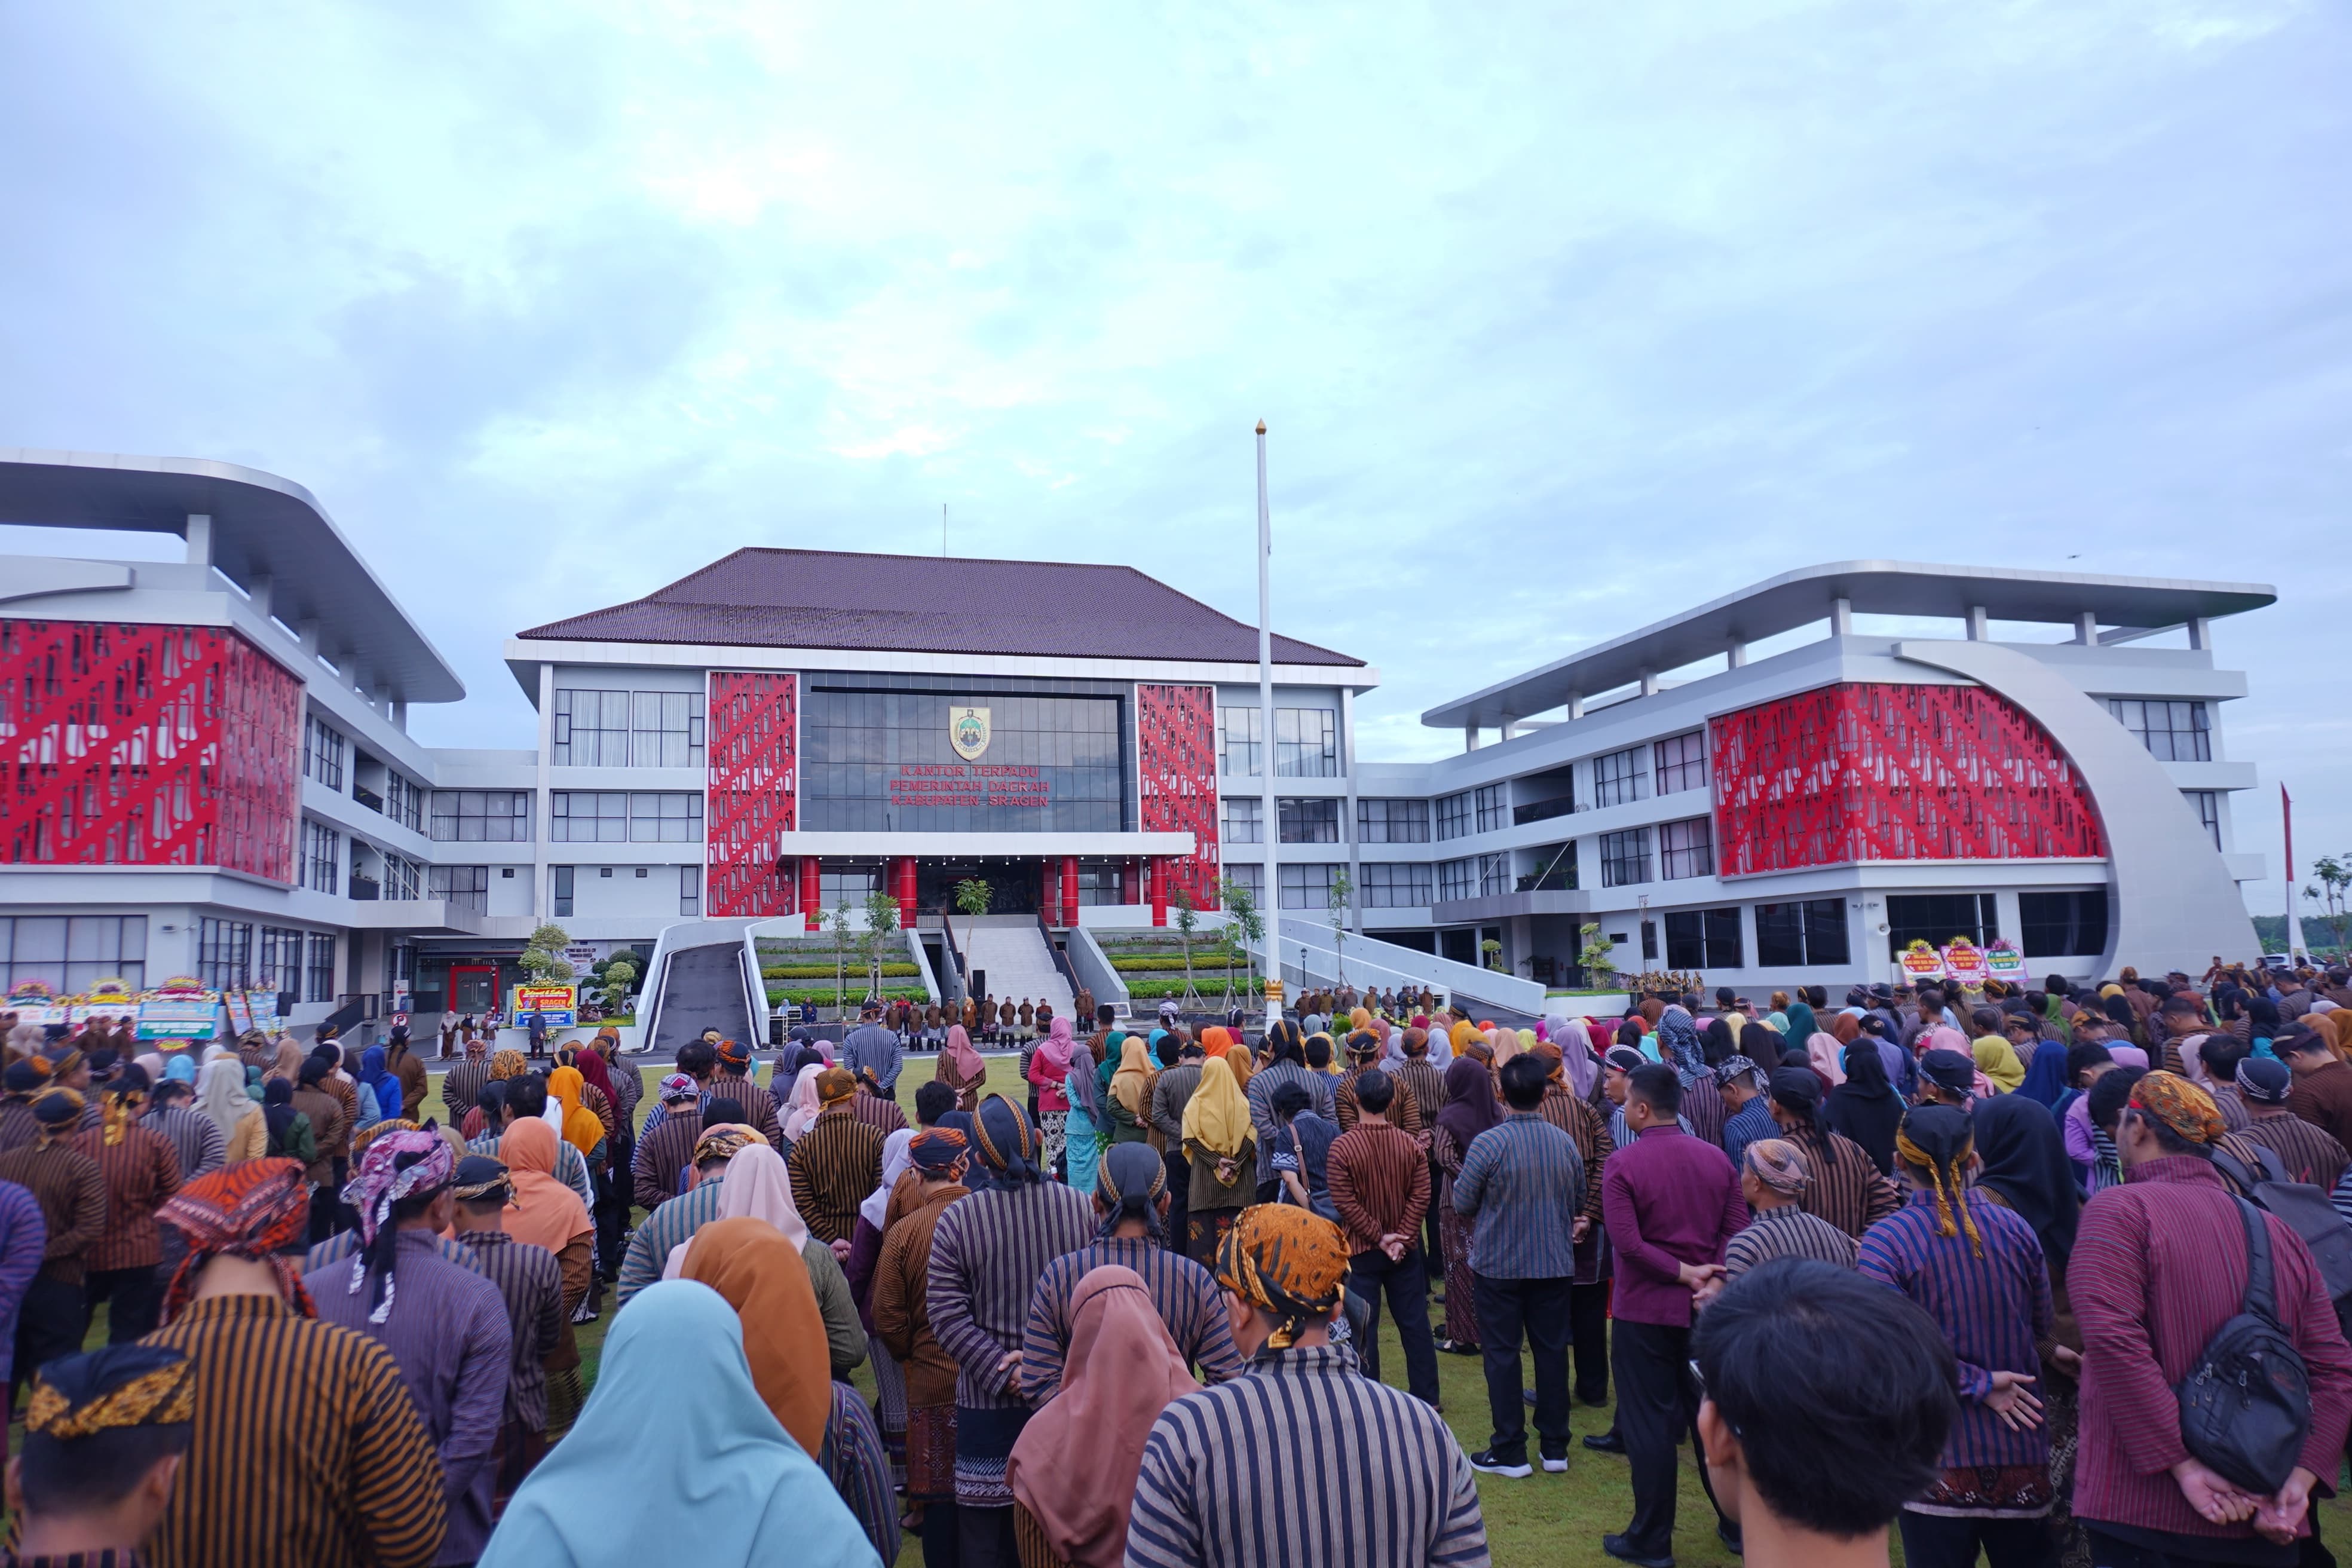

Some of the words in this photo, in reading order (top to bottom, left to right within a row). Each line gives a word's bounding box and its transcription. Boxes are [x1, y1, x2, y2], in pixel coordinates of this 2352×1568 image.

[901, 765, 965, 777] KANTOR
[971, 765, 1039, 777] TERPADU
[890, 780, 982, 791] PEMERINTAH
[988, 780, 1049, 792] DAERAH
[892, 795, 979, 806] KABUPATEN
[988, 796, 1048, 807] SRAGEN
